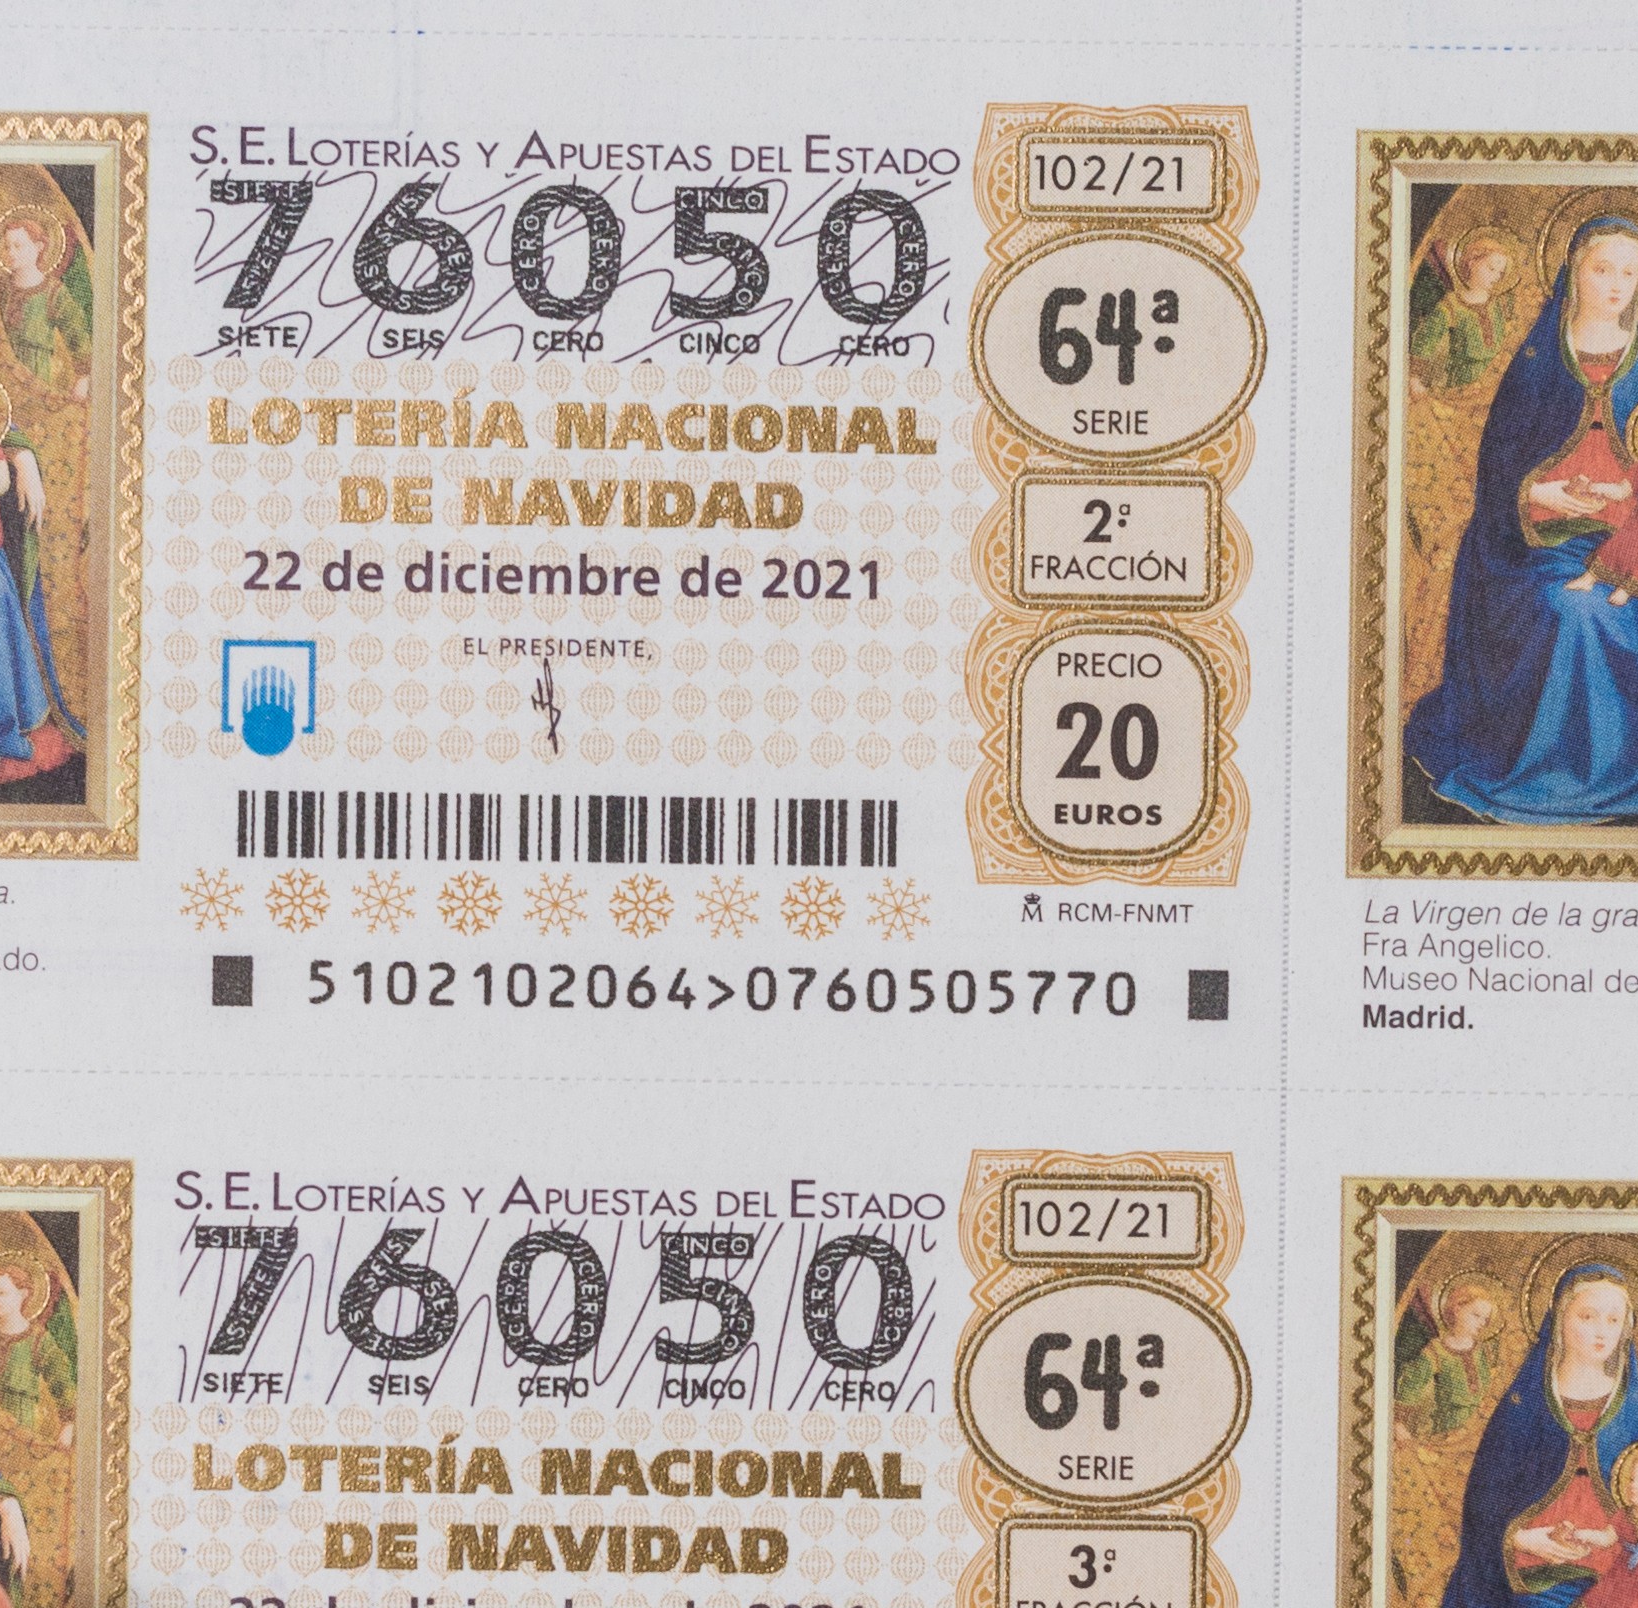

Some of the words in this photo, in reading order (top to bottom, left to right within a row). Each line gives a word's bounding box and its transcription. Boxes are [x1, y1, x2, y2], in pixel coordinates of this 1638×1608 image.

[477, 142, 499, 168] Y
[513, 129, 713, 172] APUESTAS
[730, 146, 793, 174] DEL
[804, 133, 962, 176] ESTADO
[1034, 151, 1184, 197] 102/21
[209, 179, 929, 326] 76050
[204, 386, 529, 450] LOTERÍA
[554, 400, 938, 457] NACIONAL
[338, 475, 434, 526] DE
[461, 477, 805, 532] NAVIDAD
[242, 549, 303, 592] 22
[322, 549, 385, 593] de
[403, 550, 661, 598] diciembre
[680, 555, 745, 598] de
[762, 556, 881, 600] 2021
[1363, 898, 1399, 927] La
[1412, 899, 1502, 930] Virgen
[1511, 900, 1549, 927] de
[1557, 901, 1582, 927] la
[309, 959, 1137, 1017] 5102102064>0760505770
[1362, 966, 1459, 992] Museo
[1468, 966, 1594, 993] Nacional
[1362, 1004, 1475, 1030] Madrid.
[1019, 1197, 1169, 1243] 102/21
[194, 1224, 914, 1372] 76050
[189, 1432, 514, 1496] LOTERÍA
[539, 1446, 923, 1503] NACIONAL
[323, 1521, 419, 1572] DE
[446, 1523, 790, 1578] NAVIDAD
